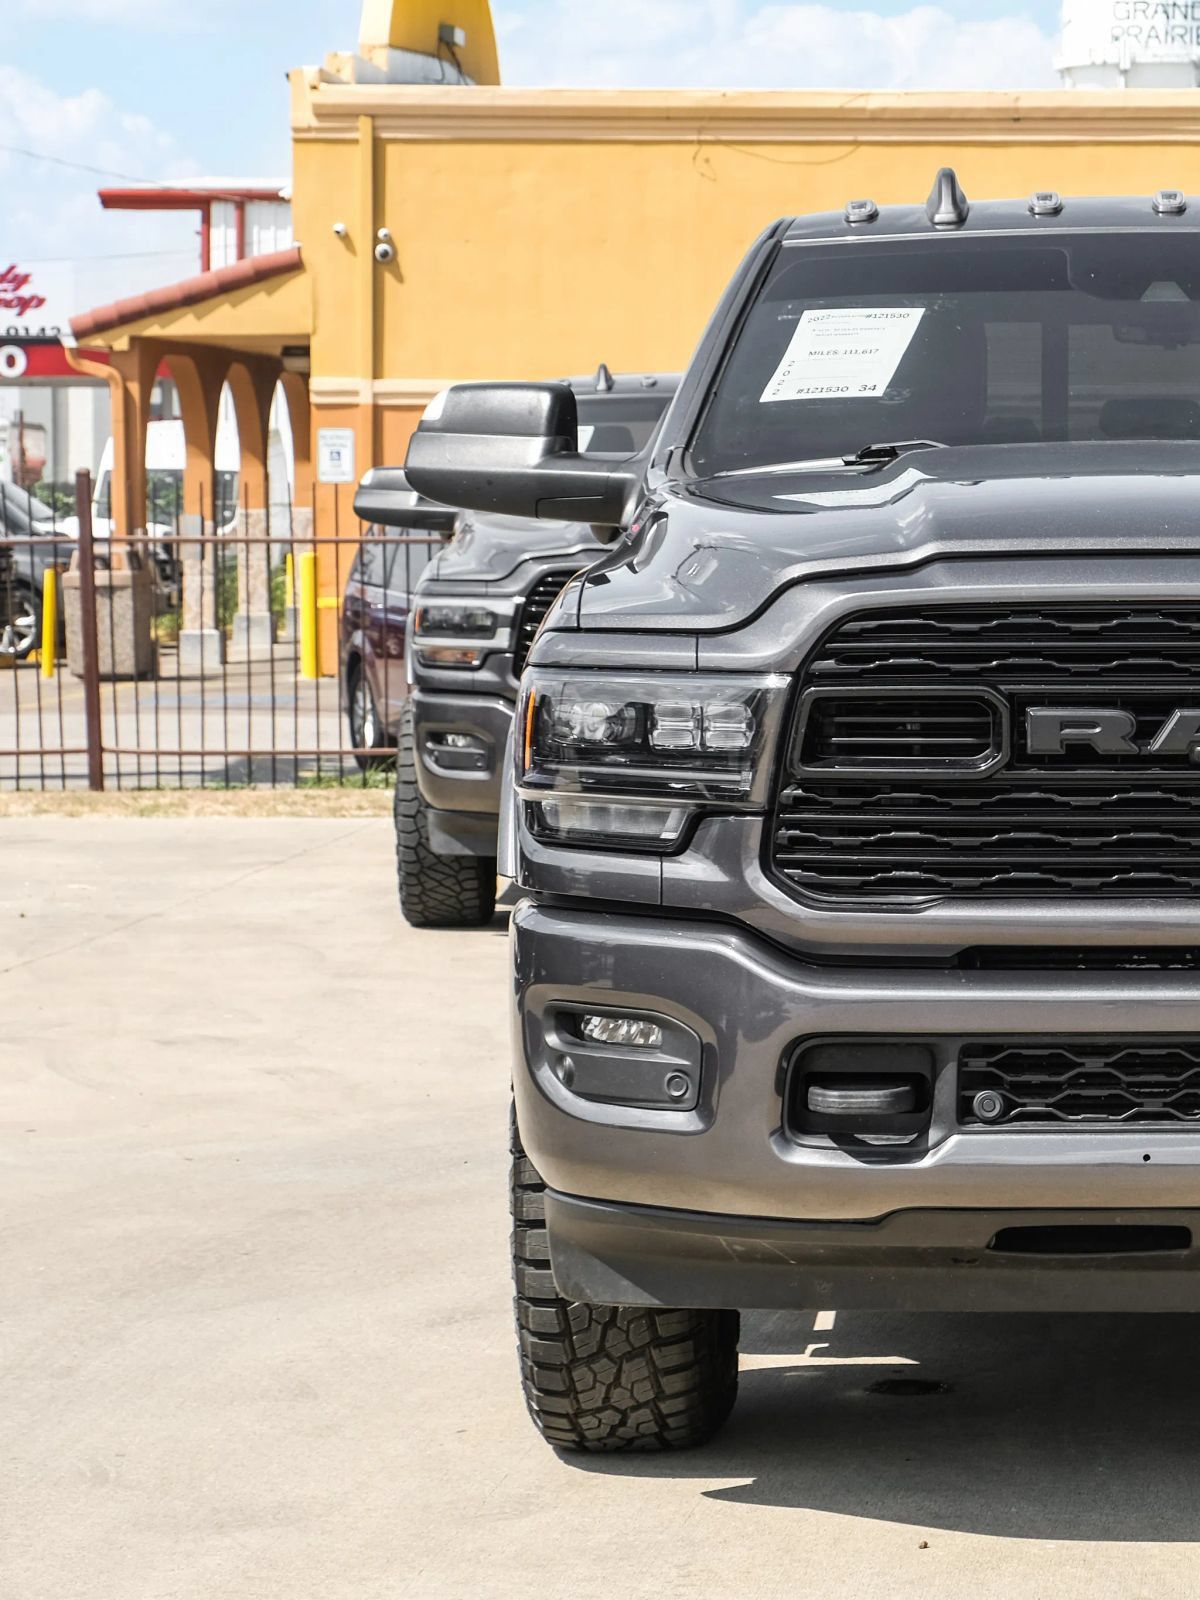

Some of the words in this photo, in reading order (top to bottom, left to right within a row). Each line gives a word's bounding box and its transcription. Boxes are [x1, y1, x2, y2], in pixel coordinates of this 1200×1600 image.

[0, 295, 46, 316] op
[796, 385, 849, 394] #121530
[858, 384, 878, 392] 34
